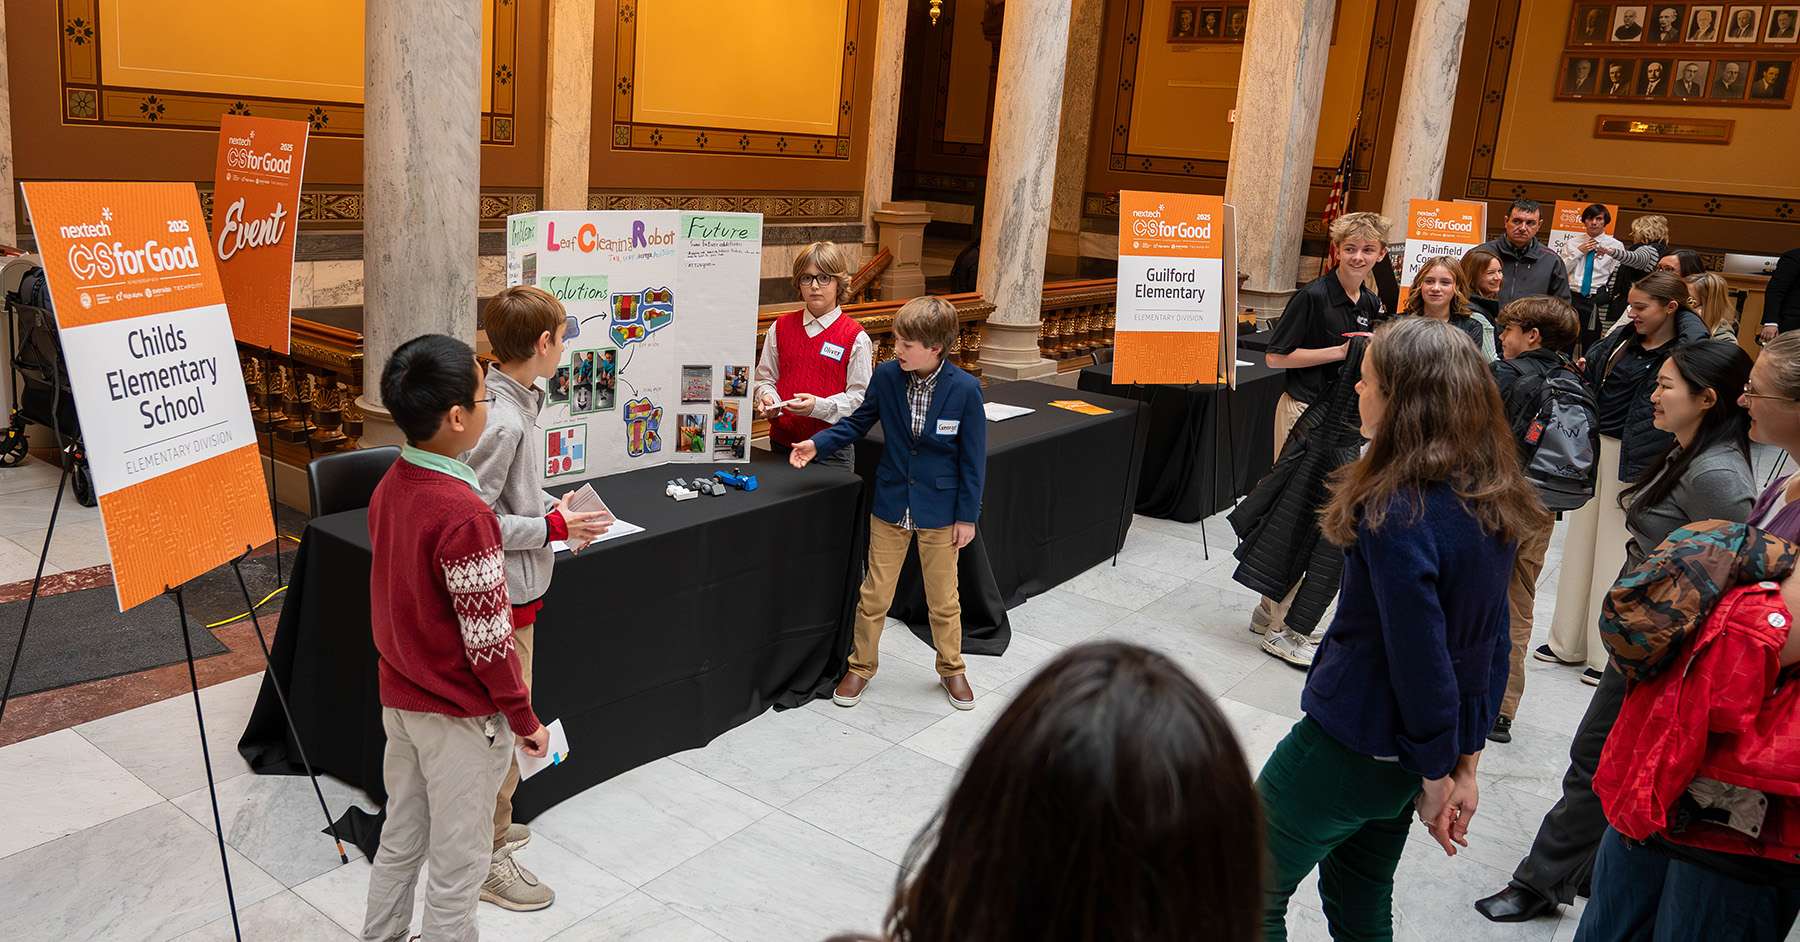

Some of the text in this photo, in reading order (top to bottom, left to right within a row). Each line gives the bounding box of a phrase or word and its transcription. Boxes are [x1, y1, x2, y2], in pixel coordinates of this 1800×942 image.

[229, 137, 251, 146] nextech
[280, 143, 294, 152] 2025
[1132, 209, 1160, 218] nextech
[1196, 213, 1211, 221] 2025
[60, 221, 111, 238] nextech
[167, 220, 189, 233] 2025
[218, 197, 287, 260] Event
[687, 216, 749, 239] Future
[1132, 219, 1211, 239] CSforGood
[547, 220, 675, 253] Leaf Cleaning Robot
[68, 237, 199, 280] CSforGood
[1421, 244, 1462, 256] Plainfield
[1146, 268, 1195, 283] Guilford
[549, 275, 608, 301] Solutions
[1135, 284, 1205, 303] Elementary
[1134, 312, 1204, 322] ELEMENTARY DIVISION
[128, 323, 187, 359] Childs
[106, 357, 217, 401] Elementary
[139, 386, 205, 429] School
[126, 430, 233, 475] ELEMENTARY DIVISION
